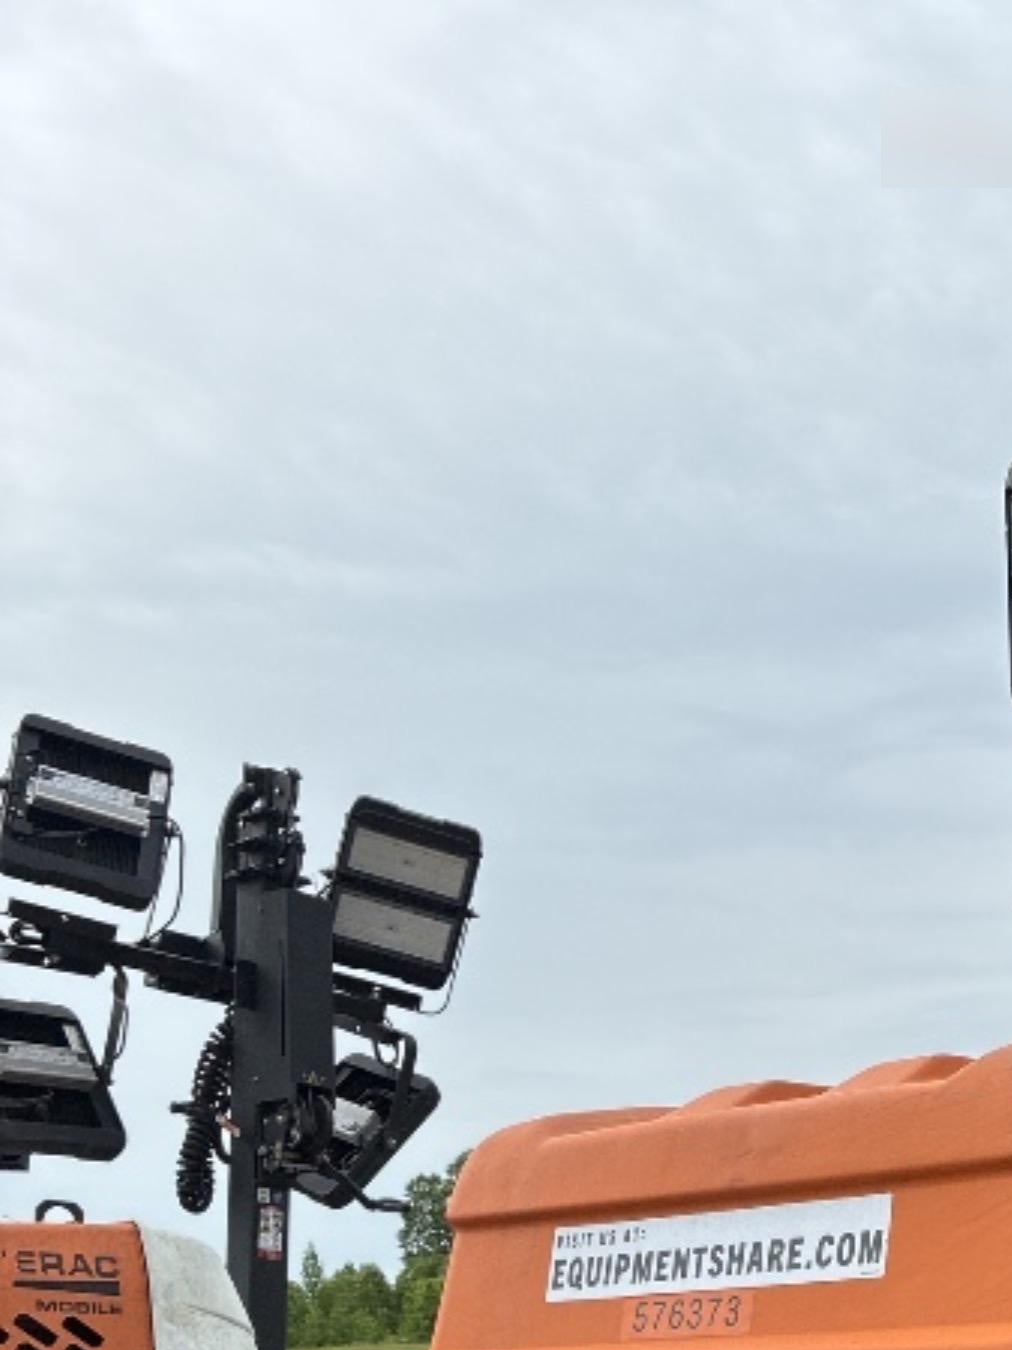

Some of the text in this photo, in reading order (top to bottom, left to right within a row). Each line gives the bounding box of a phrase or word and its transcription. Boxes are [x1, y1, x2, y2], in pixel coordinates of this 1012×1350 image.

[1, 1248, 121, 1279] ERAC
[551, 1229, 884, 1291] EQUIPMENTSHARE.COM
[632, 1295, 742, 1333] 576373
